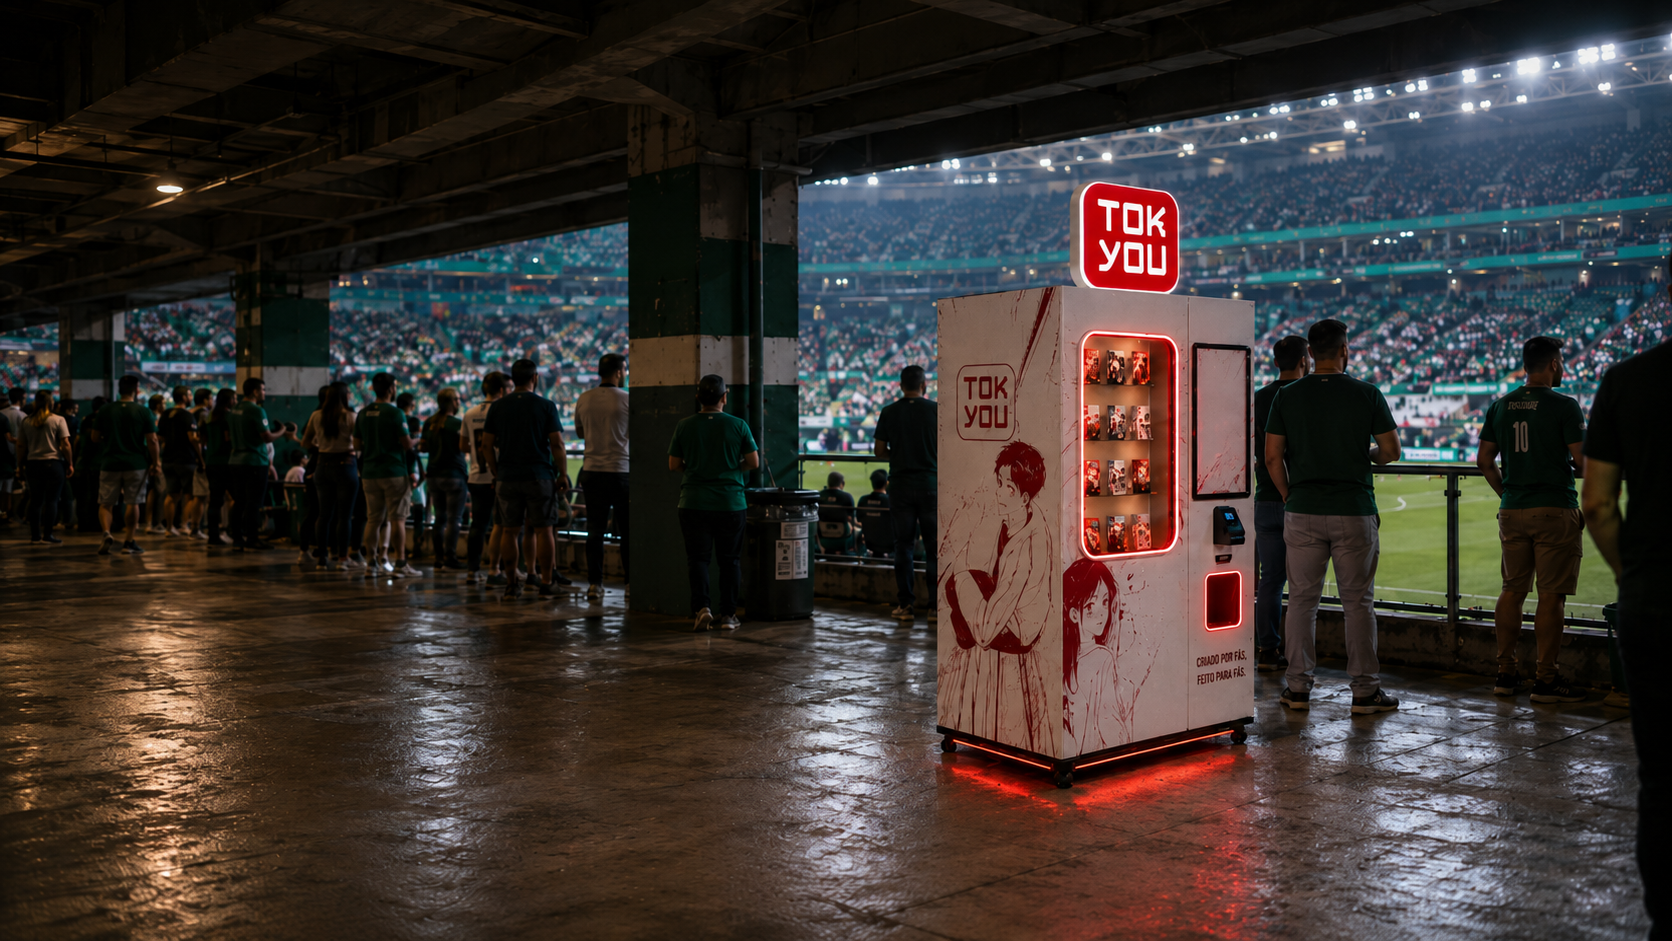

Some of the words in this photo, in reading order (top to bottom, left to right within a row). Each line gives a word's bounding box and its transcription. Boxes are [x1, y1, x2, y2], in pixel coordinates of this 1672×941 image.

[1097, 198, 1166, 237] TOK
[1098, 239, 1167, 276] YOU
[963, 375, 1008, 400] TOK
[963, 404, 1008, 429] YOU
[1512, 420, 1529, 453] 10
[1196, 653, 1220, 668] CRIADO
[1220, 651, 1233, 664] POR
[1197, 672, 1215, 686] FEITO
[1215, 668, 1233, 682] PARA
